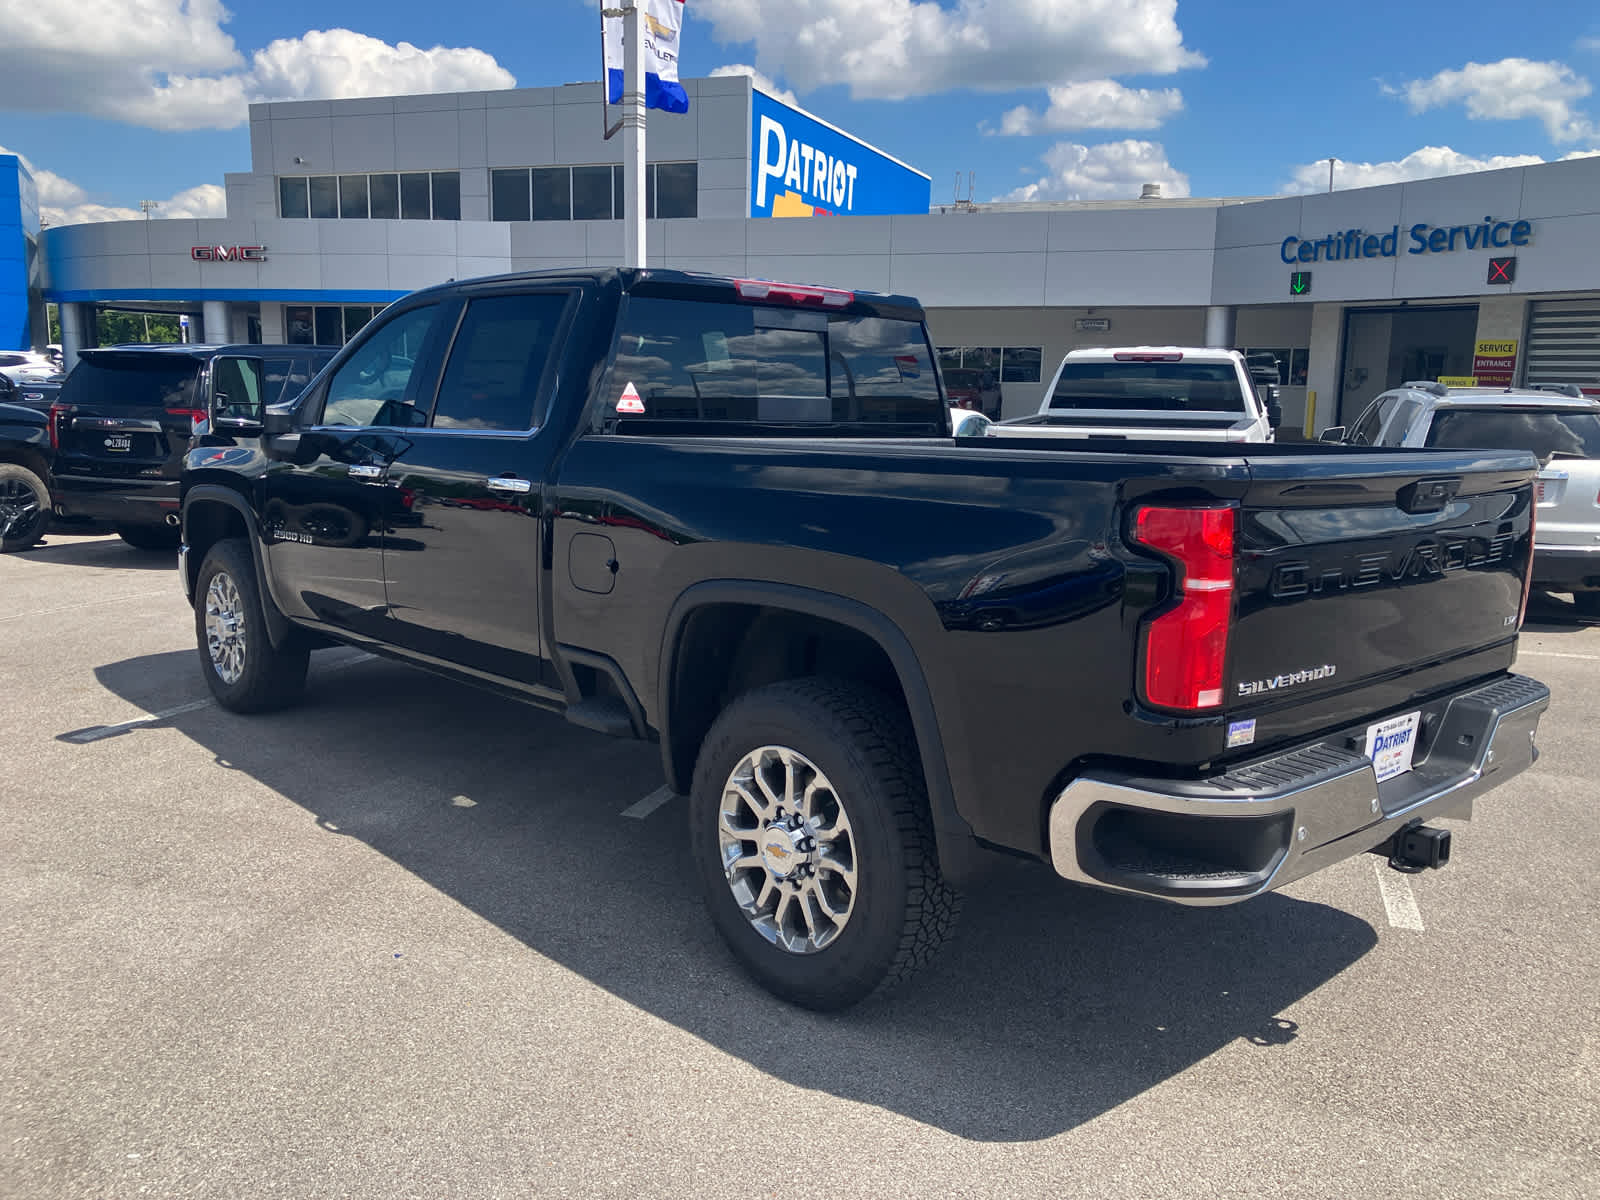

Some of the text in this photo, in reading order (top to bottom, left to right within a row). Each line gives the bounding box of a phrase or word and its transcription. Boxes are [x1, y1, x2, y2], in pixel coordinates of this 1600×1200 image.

[756, 114, 857, 211] PATRIOT
[1281, 216, 1531, 264] Certified Service
[191, 245, 265, 262] GMC
[1479, 343, 1514, 353] SERVICE
[1476, 360, 1512, 368] ENTRANCE
[273, 529, 313, 544] 2500 HD
[1238, 664, 1337, 697] SILVERADO
[1371, 728, 1413, 762] PATRIOT
